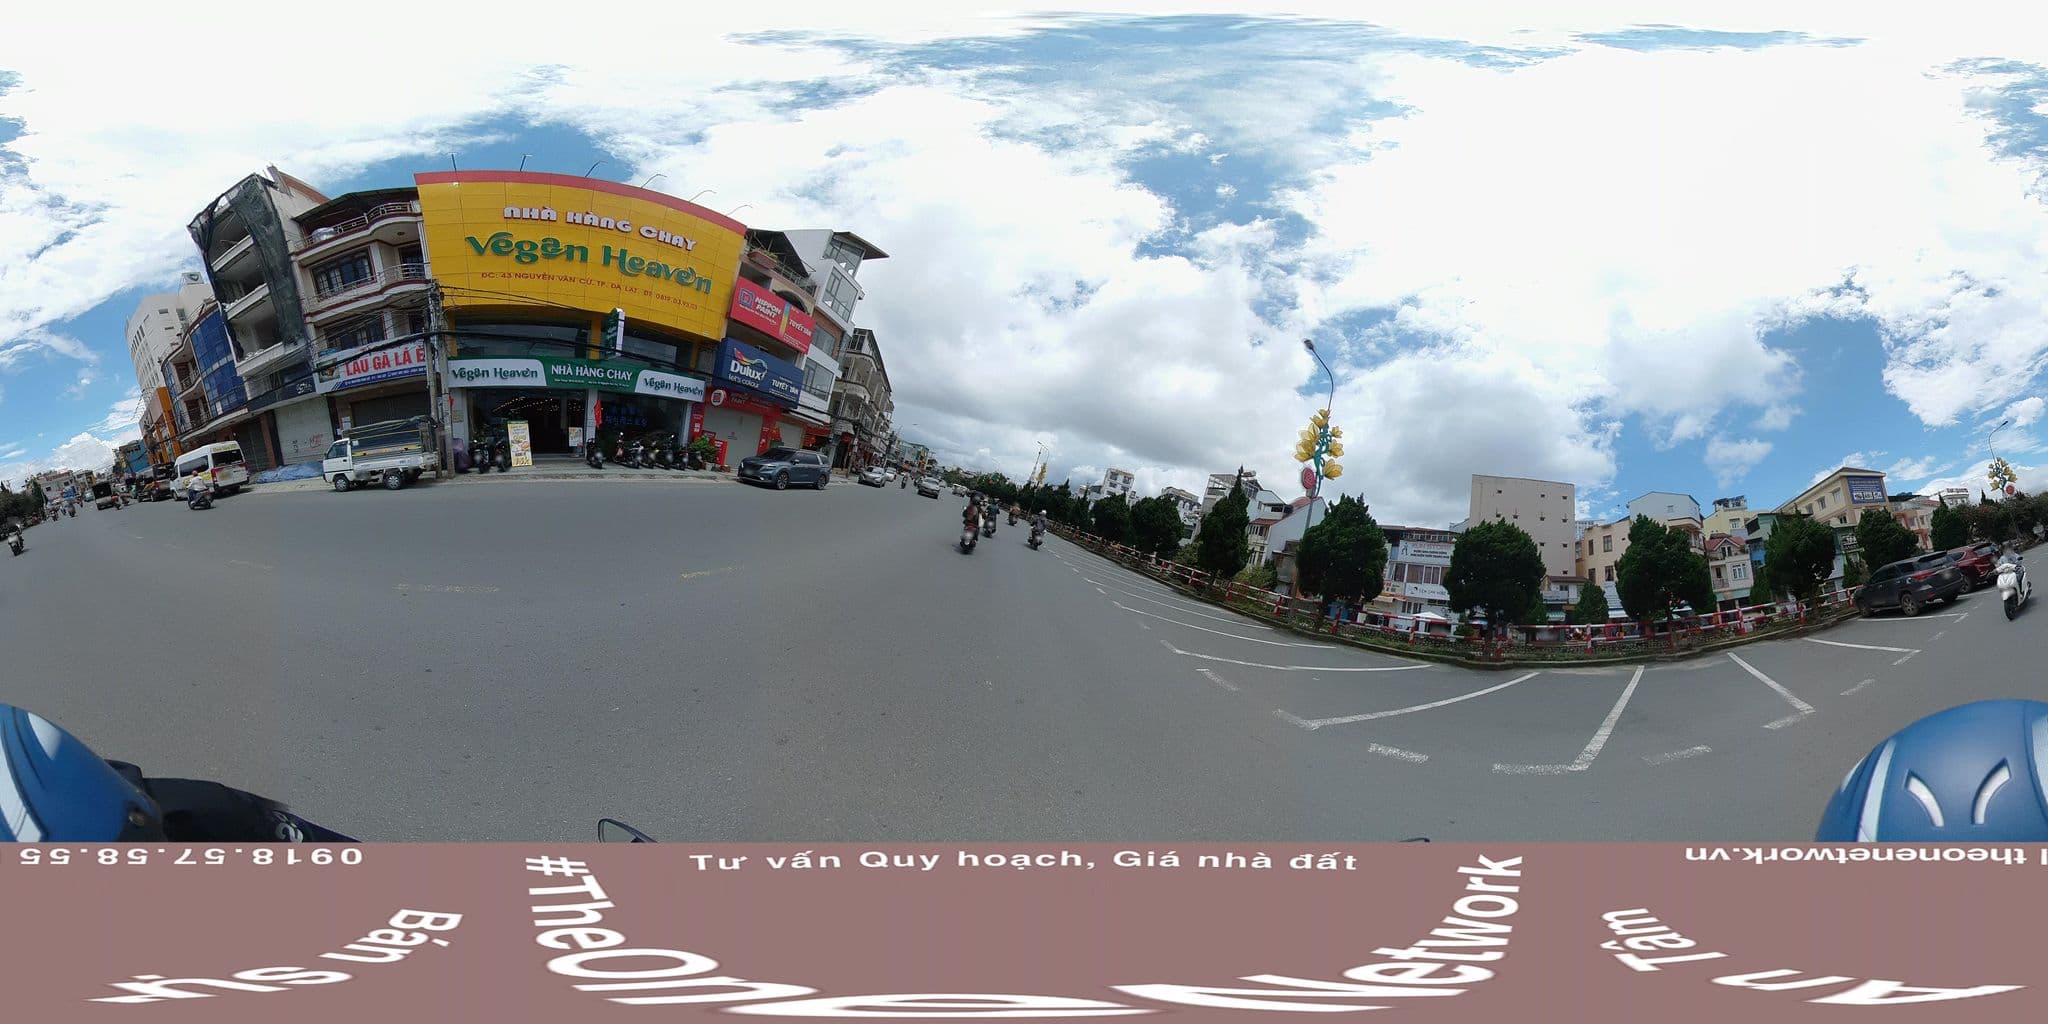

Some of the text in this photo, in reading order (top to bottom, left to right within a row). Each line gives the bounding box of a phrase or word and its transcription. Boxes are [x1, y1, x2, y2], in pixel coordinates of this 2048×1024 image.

[504, 206, 697, 251] NHÀ HÀNG CHAY
[500, 272, 512, 280] 43
[602, 245, 712, 295] Heaven
[755, 296, 781, 315] NIPPON
[756, 304, 777, 318] PAINT
[372, 351, 391, 371] GÀ
[730, 359, 761, 381] Dulux
[493, 367, 538, 379] Heaven
[551, 364, 632, 381] NHÀ HÀNG CHAY
